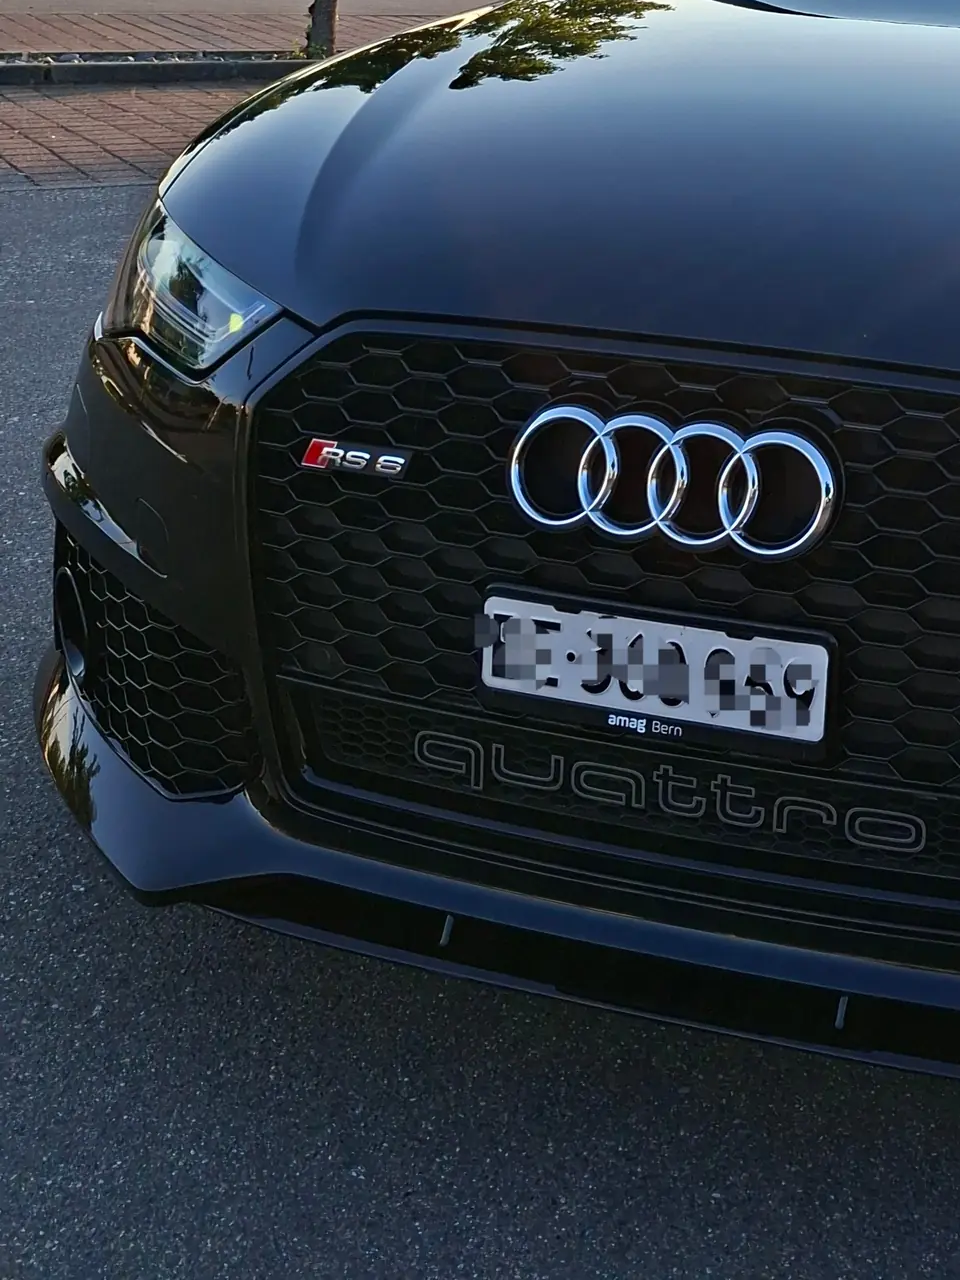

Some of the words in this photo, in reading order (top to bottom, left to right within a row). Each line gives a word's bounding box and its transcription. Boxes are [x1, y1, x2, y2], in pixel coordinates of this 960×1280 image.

[607, 714, 647, 733] amag
[651, 721, 683, 736] Bern
[414, 730, 926, 852] quattro
